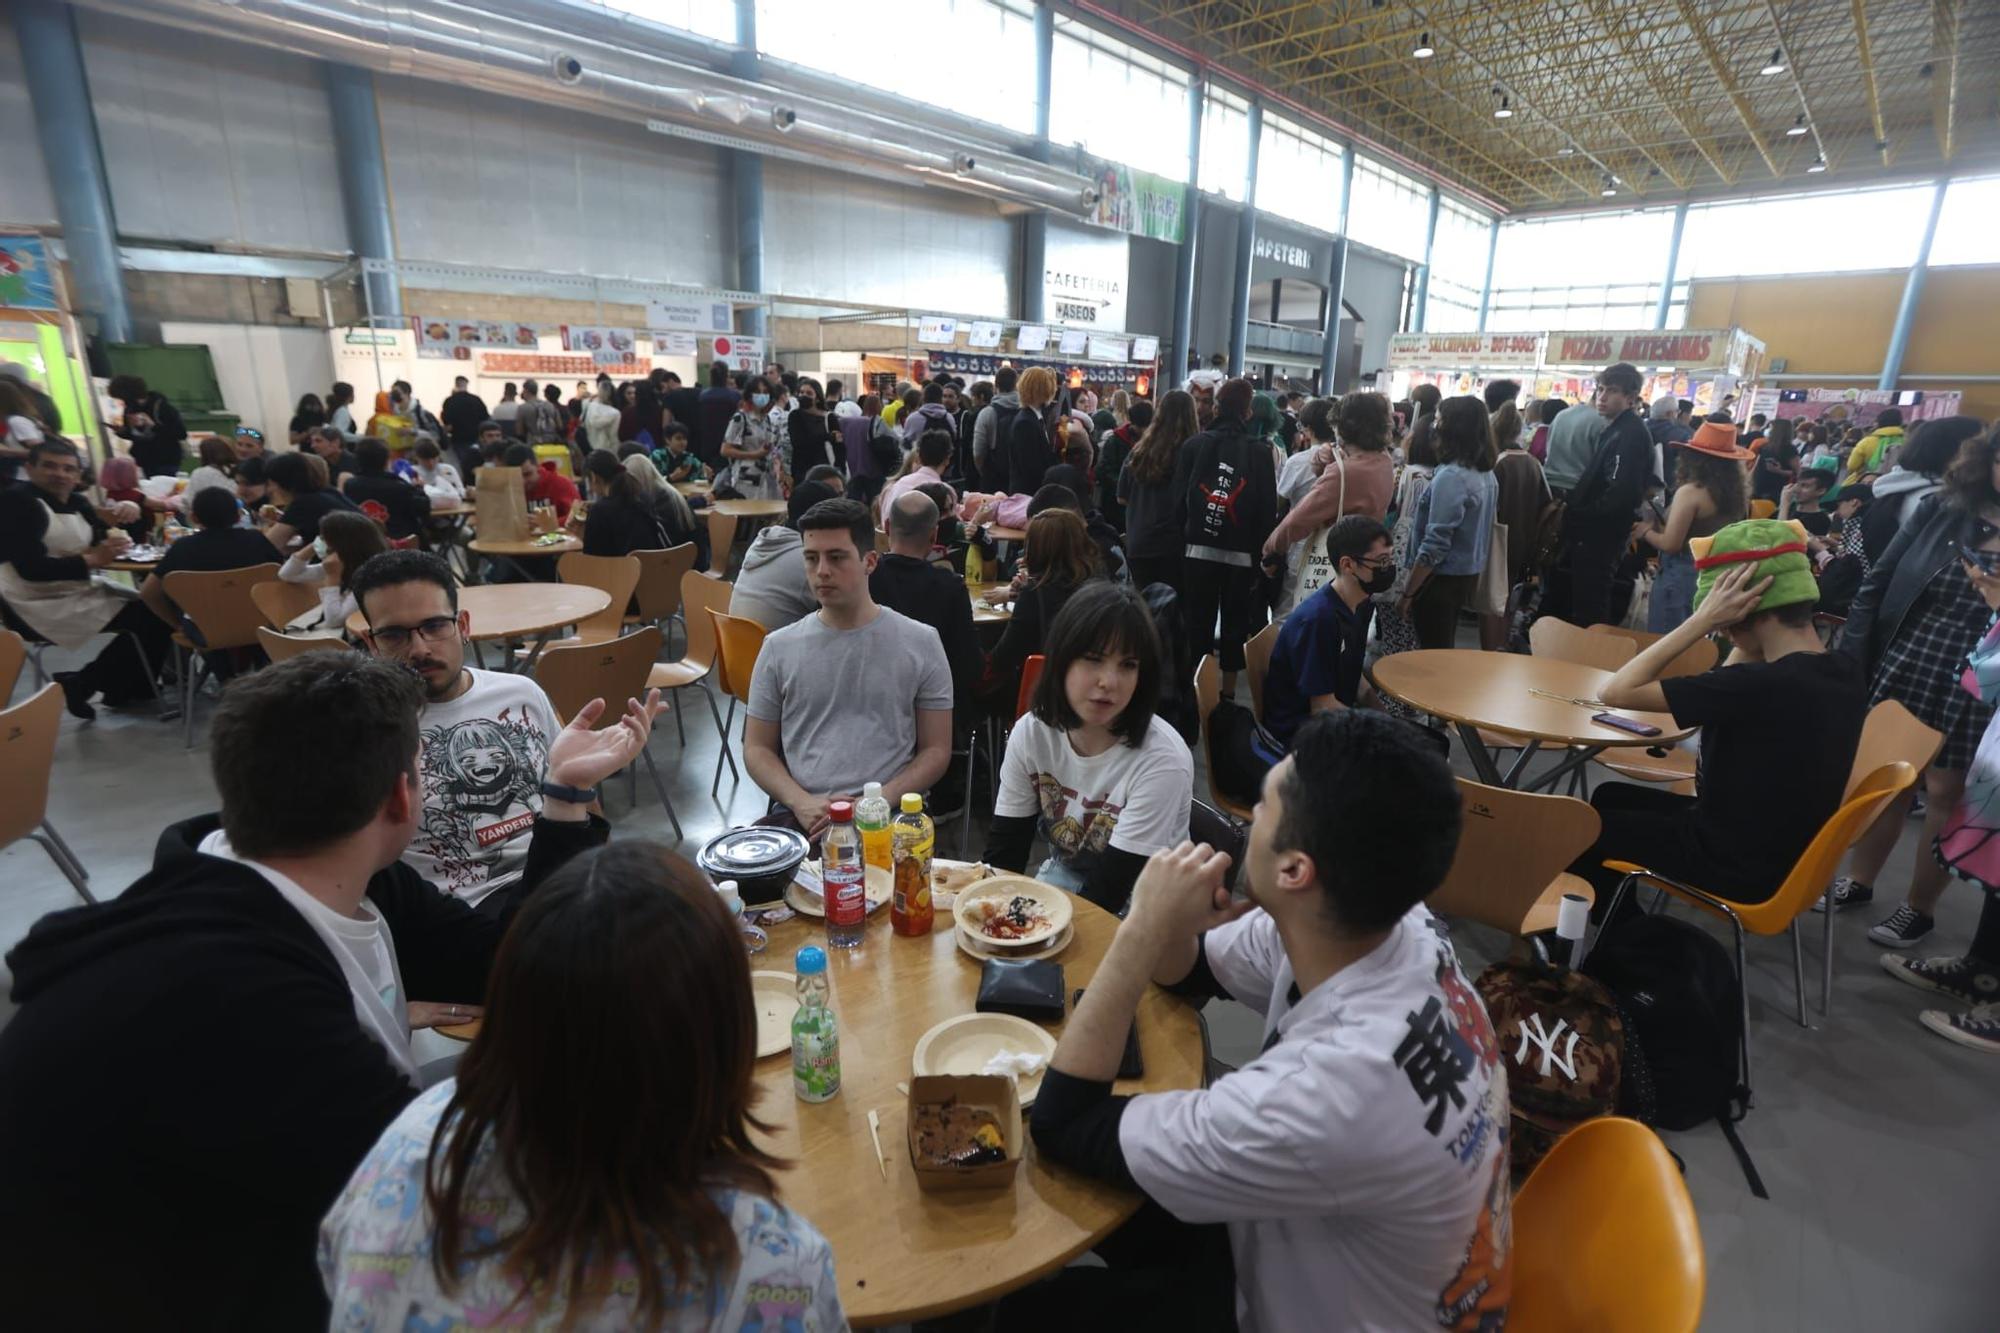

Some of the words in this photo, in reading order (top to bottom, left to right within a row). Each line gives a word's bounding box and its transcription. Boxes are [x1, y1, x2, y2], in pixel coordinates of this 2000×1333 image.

[1046, 270, 1119, 294] CAFETERIA
[1560, 336, 1613, 361] PIZZAS
[1618, 336, 1712, 361] ARTESANAS
[478, 815, 534, 842] YANDERE
[1515, 1012, 1580, 1081] NY
[1393, 995, 1470, 1137] 東
